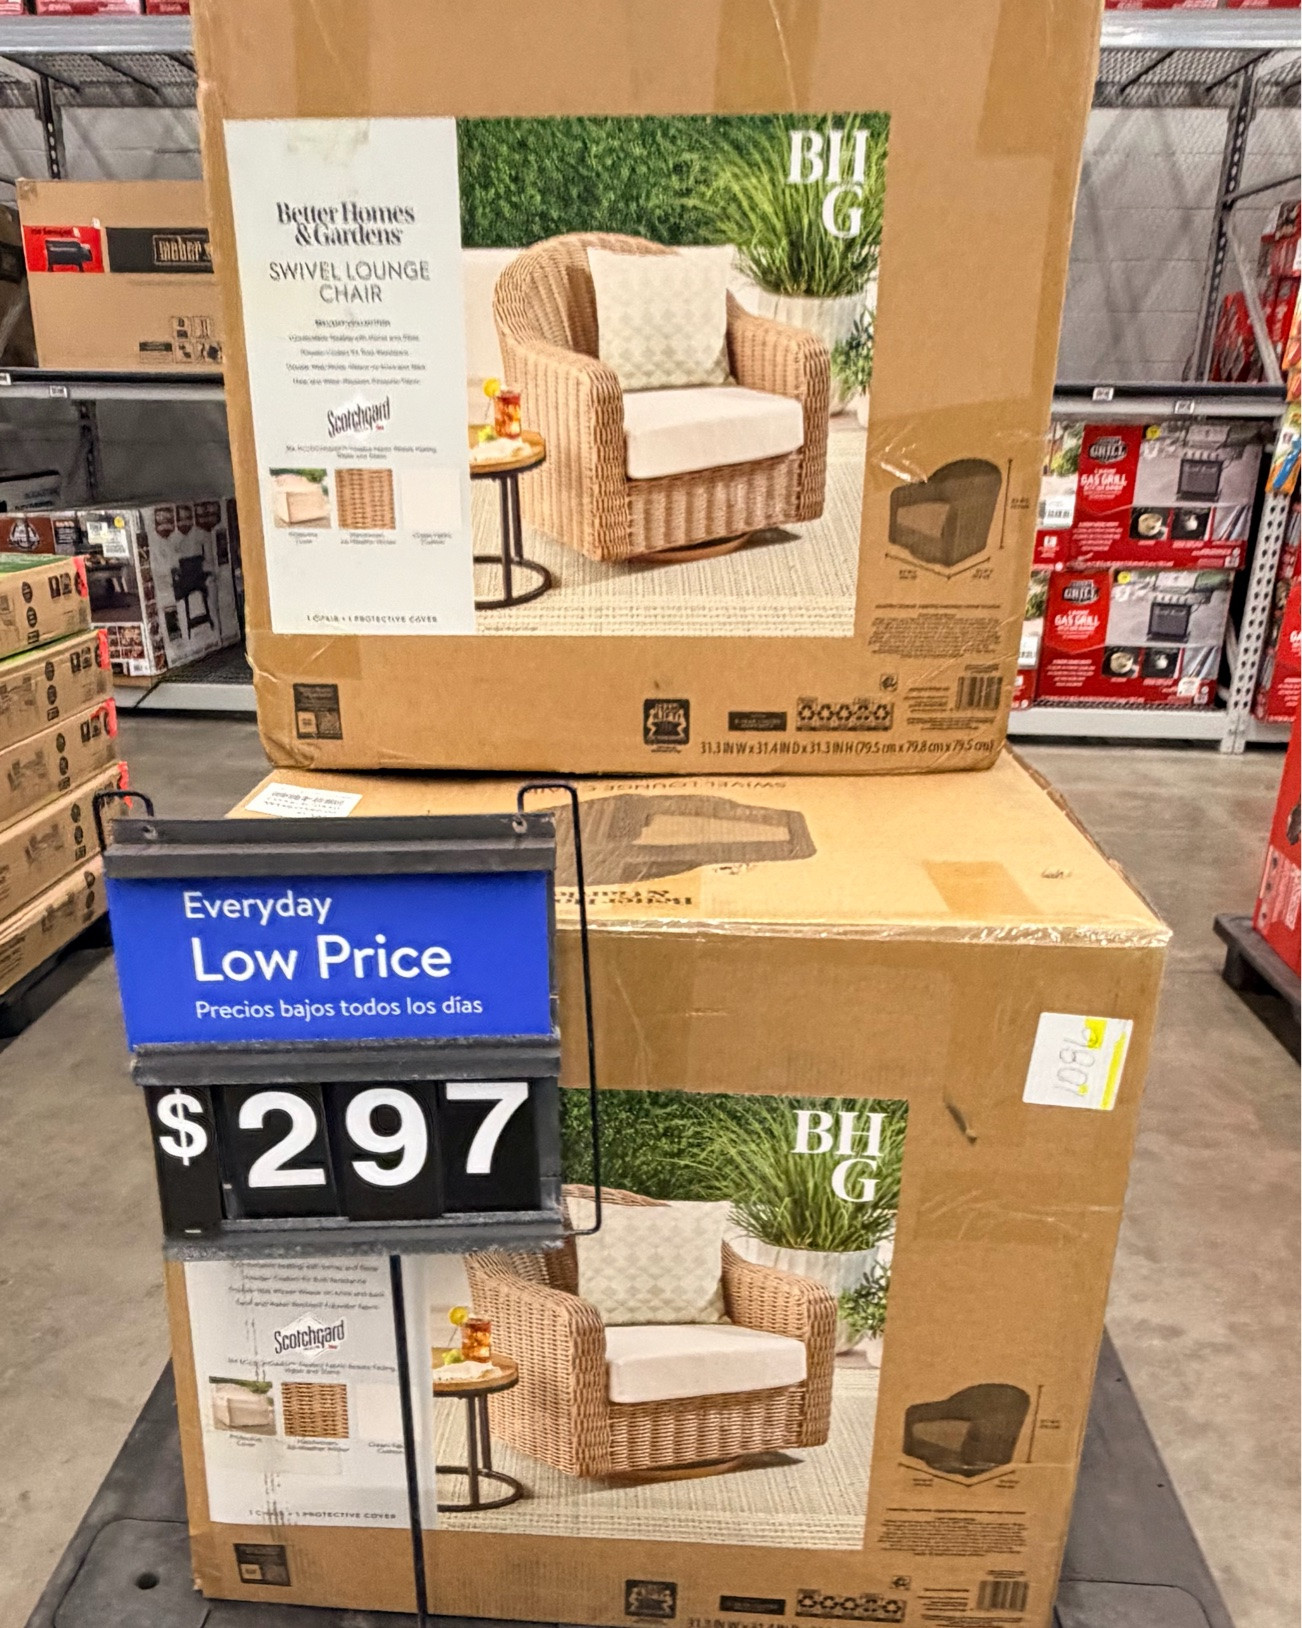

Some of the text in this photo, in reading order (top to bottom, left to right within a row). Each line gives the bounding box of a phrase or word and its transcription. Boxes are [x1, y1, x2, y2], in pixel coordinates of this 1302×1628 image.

[276, 201, 415, 224] Better Homes
[822, 184, 863, 239] G
[269, 260, 430, 281] SWIVEL LOUNGE
[319, 284, 382, 303] CHAIR
[327, 395, 391, 438] Scotchgard
[183, 889, 332, 926] Everyday
[191, 933, 452, 982] Low Price
[196, 995, 483, 1022] Precios bajos todos los días
[789, 1109, 889, 1157] BH
[831, 1157, 881, 1203] G
[274, 1320, 346, 1355] Scotchgard
[302, 1510, 361, 1519] PROTECTIVE
